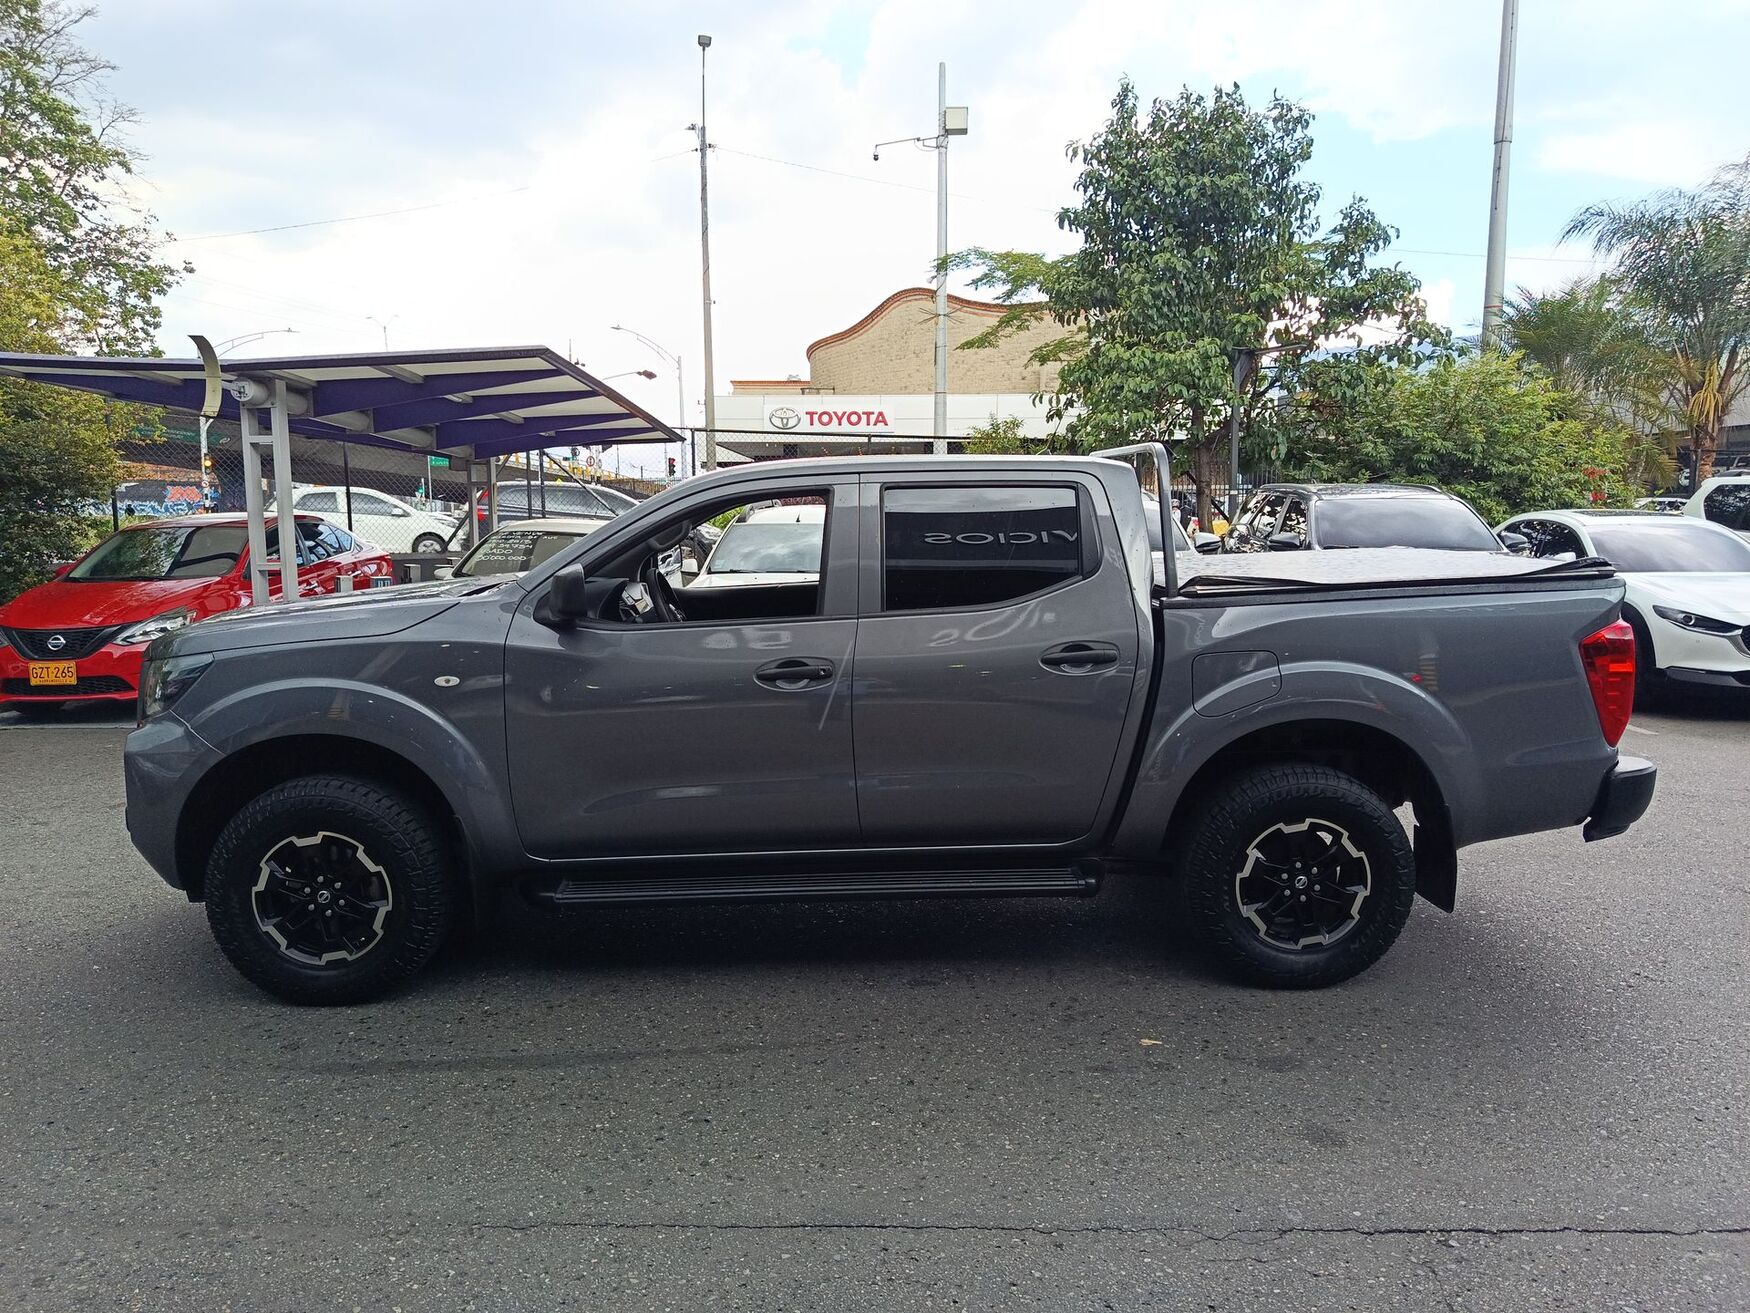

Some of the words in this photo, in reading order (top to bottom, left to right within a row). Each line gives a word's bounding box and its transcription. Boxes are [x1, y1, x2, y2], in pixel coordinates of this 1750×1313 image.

[805, 411, 889, 426] TOYOTA
[31, 666, 50, 679] GZT
[53, 666, 74, 679] 265
